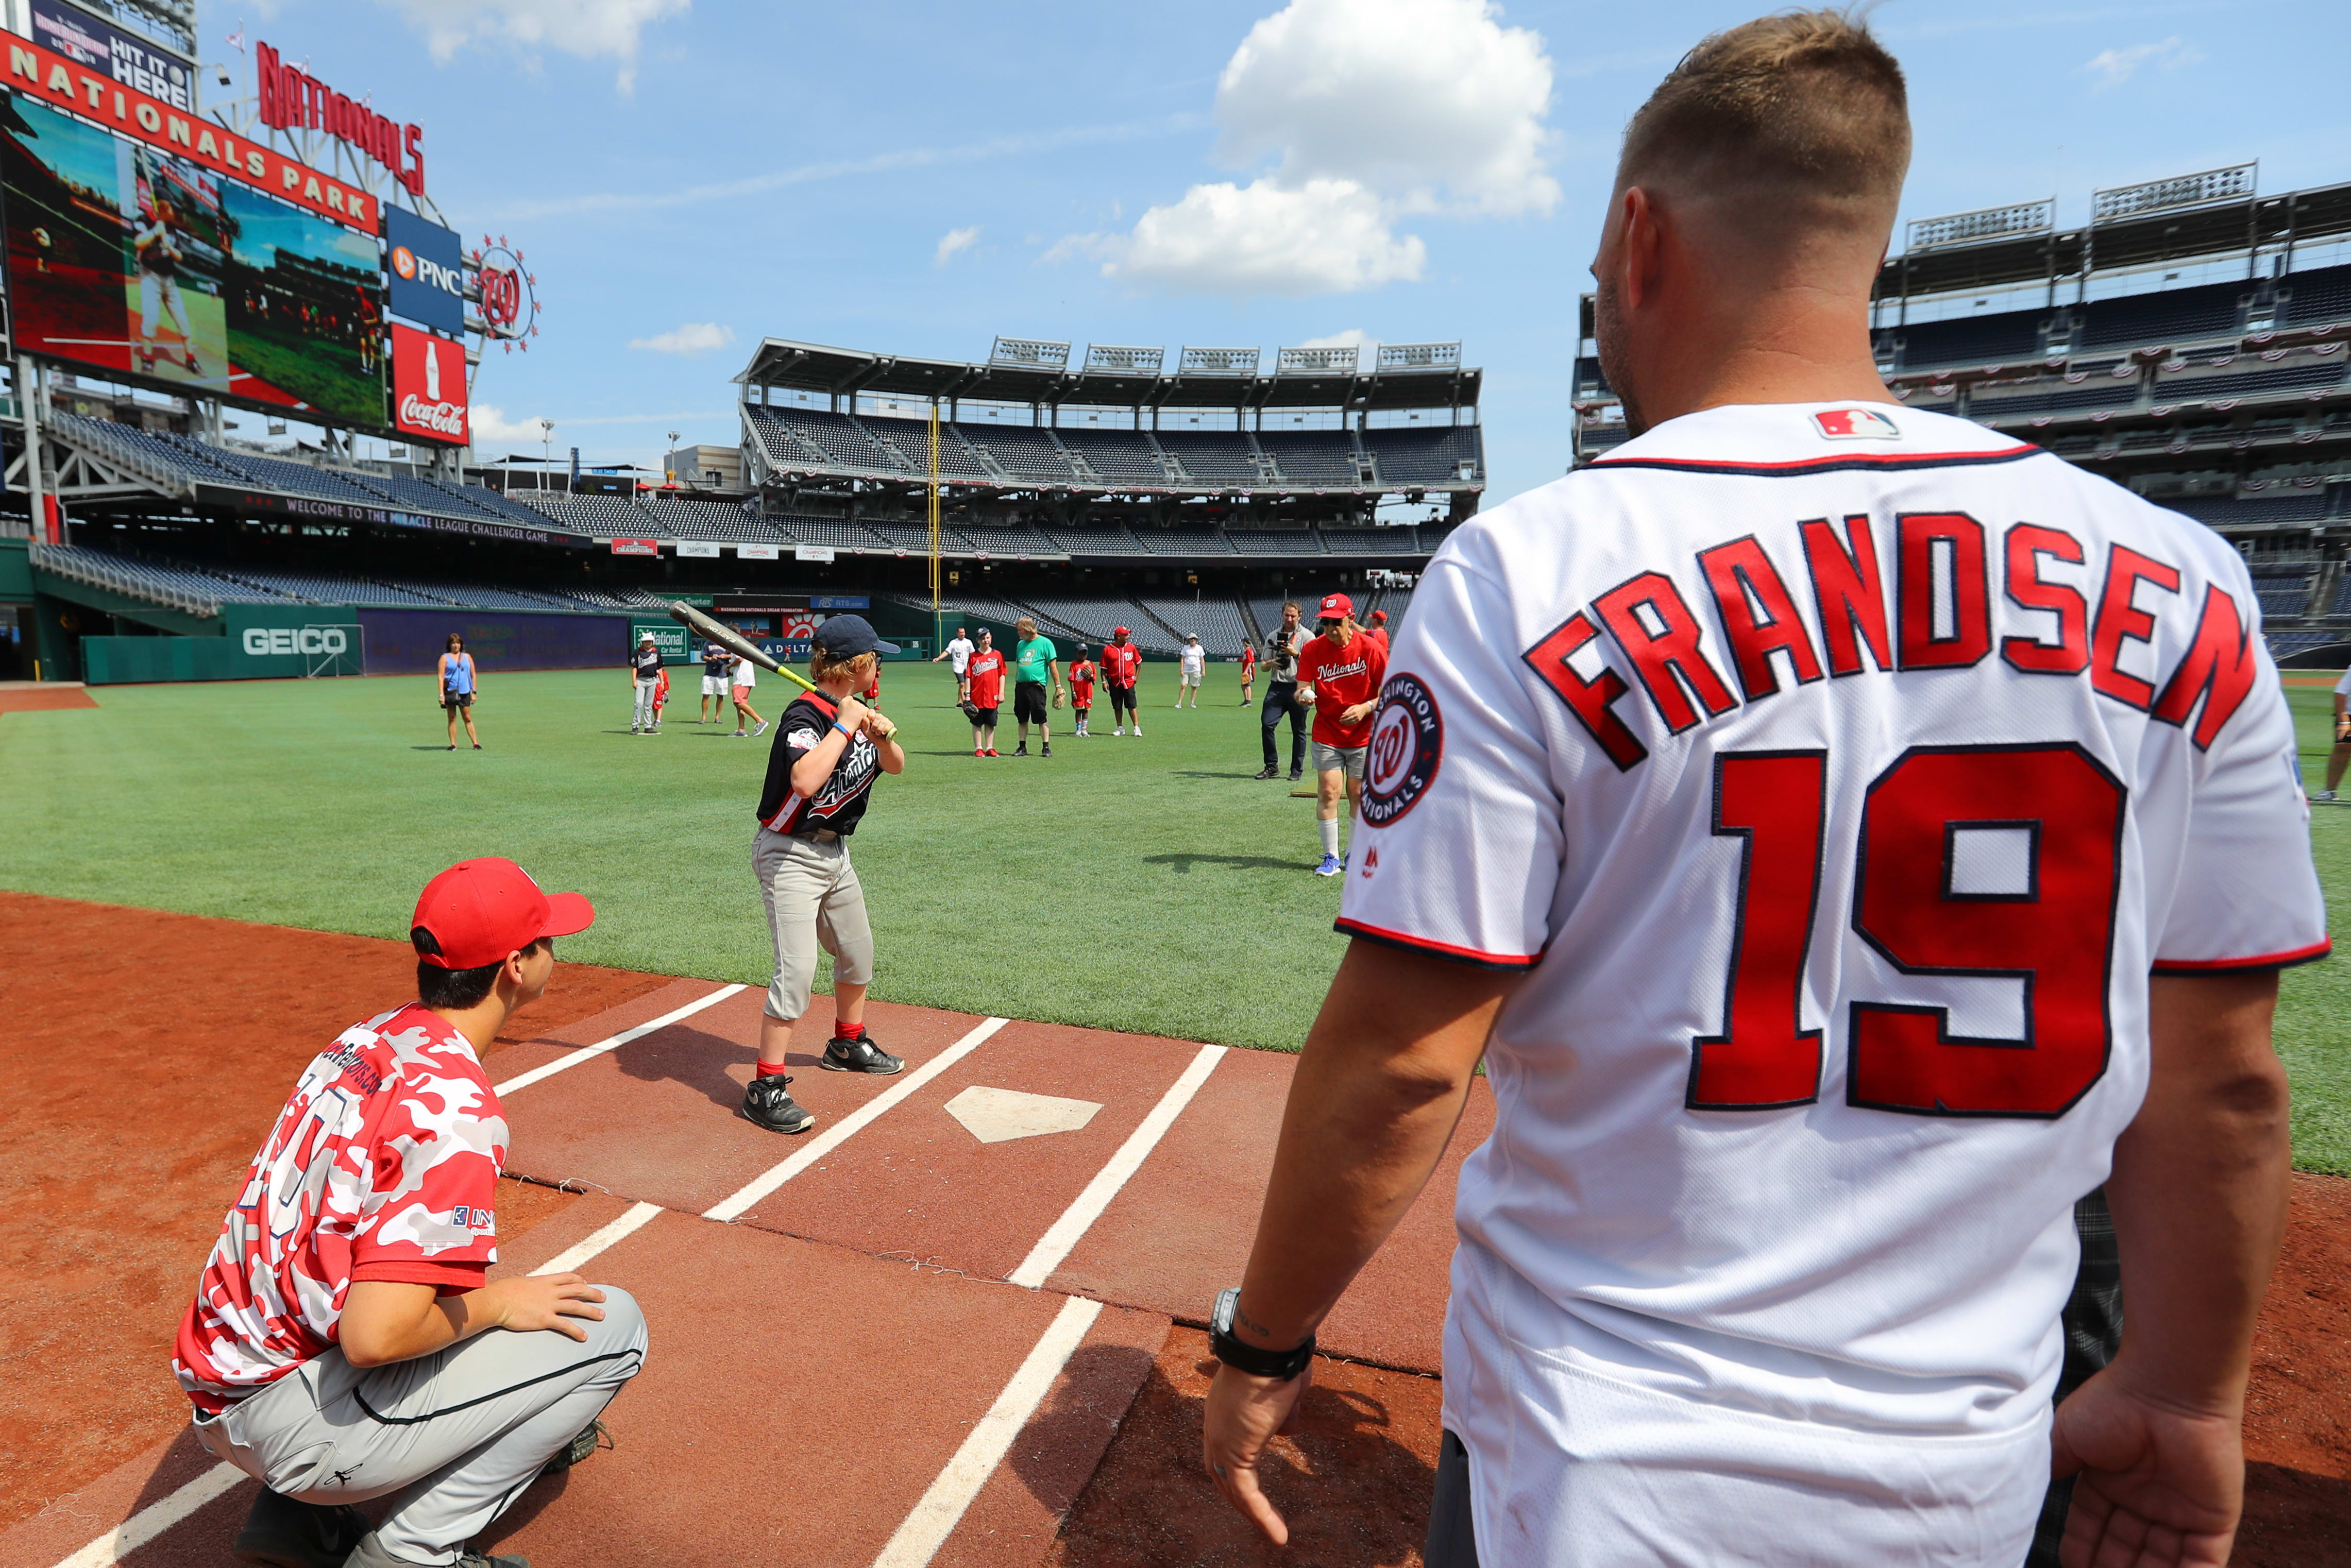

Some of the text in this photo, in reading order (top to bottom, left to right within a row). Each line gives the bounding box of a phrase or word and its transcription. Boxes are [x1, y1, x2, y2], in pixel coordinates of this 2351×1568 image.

[110, 36, 167, 78] HIT IT
[111, 55, 189, 113] HERE
[10, 44, 266, 178] NATIONALS
[282, 165, 365, 221] PARK
[256, 40, 424, 196] NATIONALS
[416, 256, 462, 297] PNC
[286, 499, 548, 542] WELCOME TO THE MIRACLE LEAGUE CHALLENGER GAME
[687, 546, 709, 554] CHAMPIONS
[1326, 599, 1337, 608] W
[242, 628, 347, 655] GEICO
[707, 625, 737, 643] EASTON
[1522, 510, 2256, 773] FRANDSEN
[1124, 652, 1133, 661] W
[1317, 656, 1366, 680] Nationals
[1362, 774, 1423, 821] NATIONALS
[1685, 742, 2129, 1119] 19
